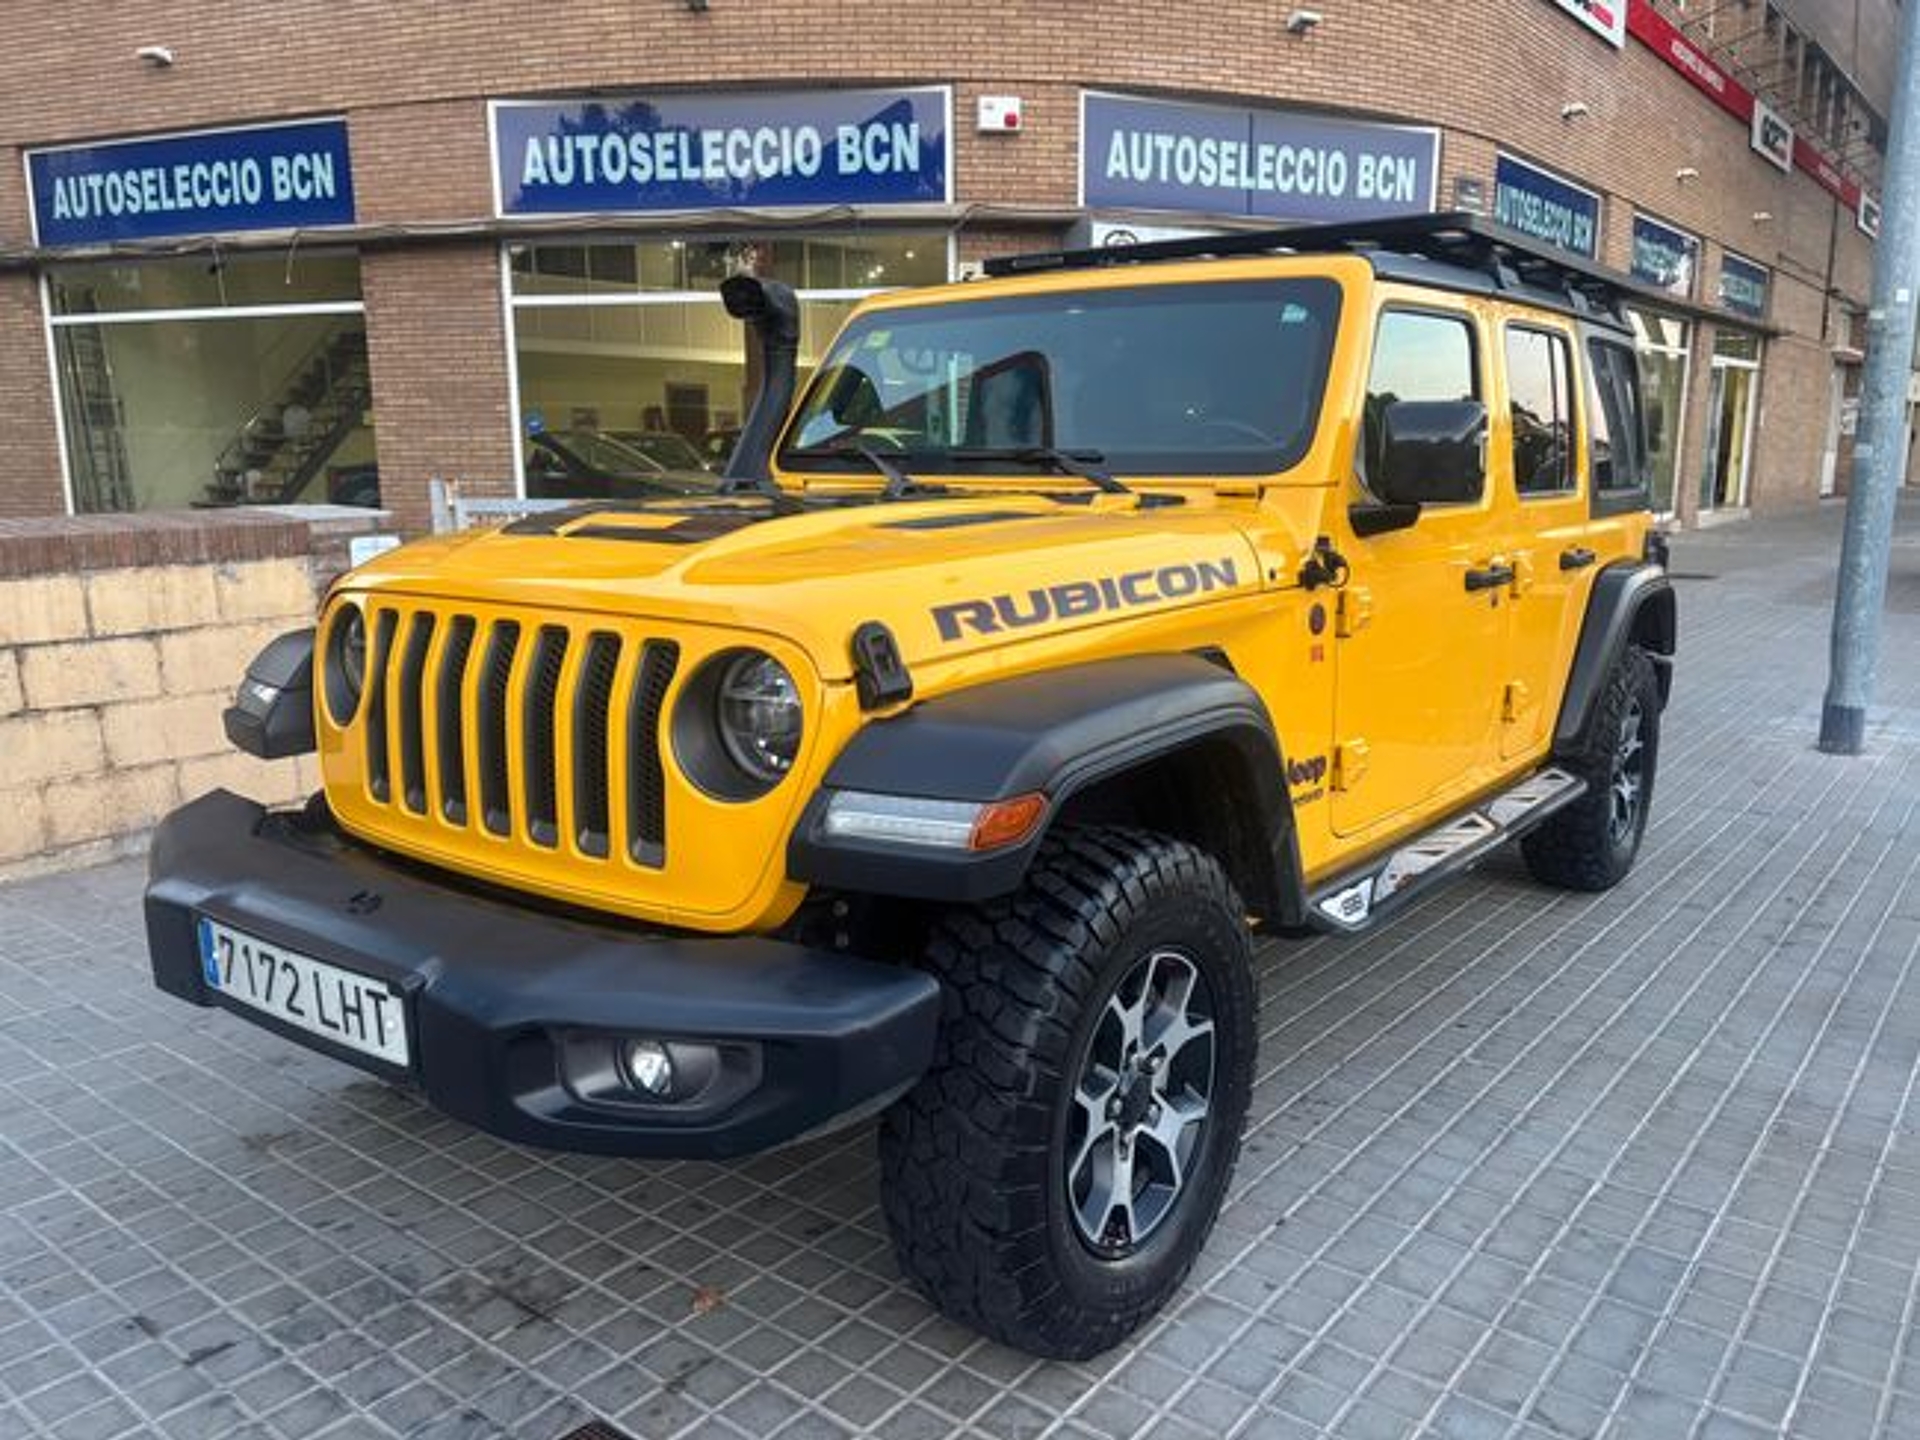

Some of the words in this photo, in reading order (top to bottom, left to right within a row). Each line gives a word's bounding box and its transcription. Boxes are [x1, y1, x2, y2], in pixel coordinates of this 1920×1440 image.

[53, 157, 262, 220] AUTOSELECCIO
[271, 152, 336, 202] BCN
[523, 126, 822, 186] AUTOSELECCIO
[838, 123, 920, 174] BCN
[1106, 130, 1348, 197] AUTOSELECCIO
[1357, 154, 1417, 202] BCN
[930, 557, 1239, 642] RUBICON
[218, 934, 305, 1017] 7172
[312, 971, 388, 1048] LHT
